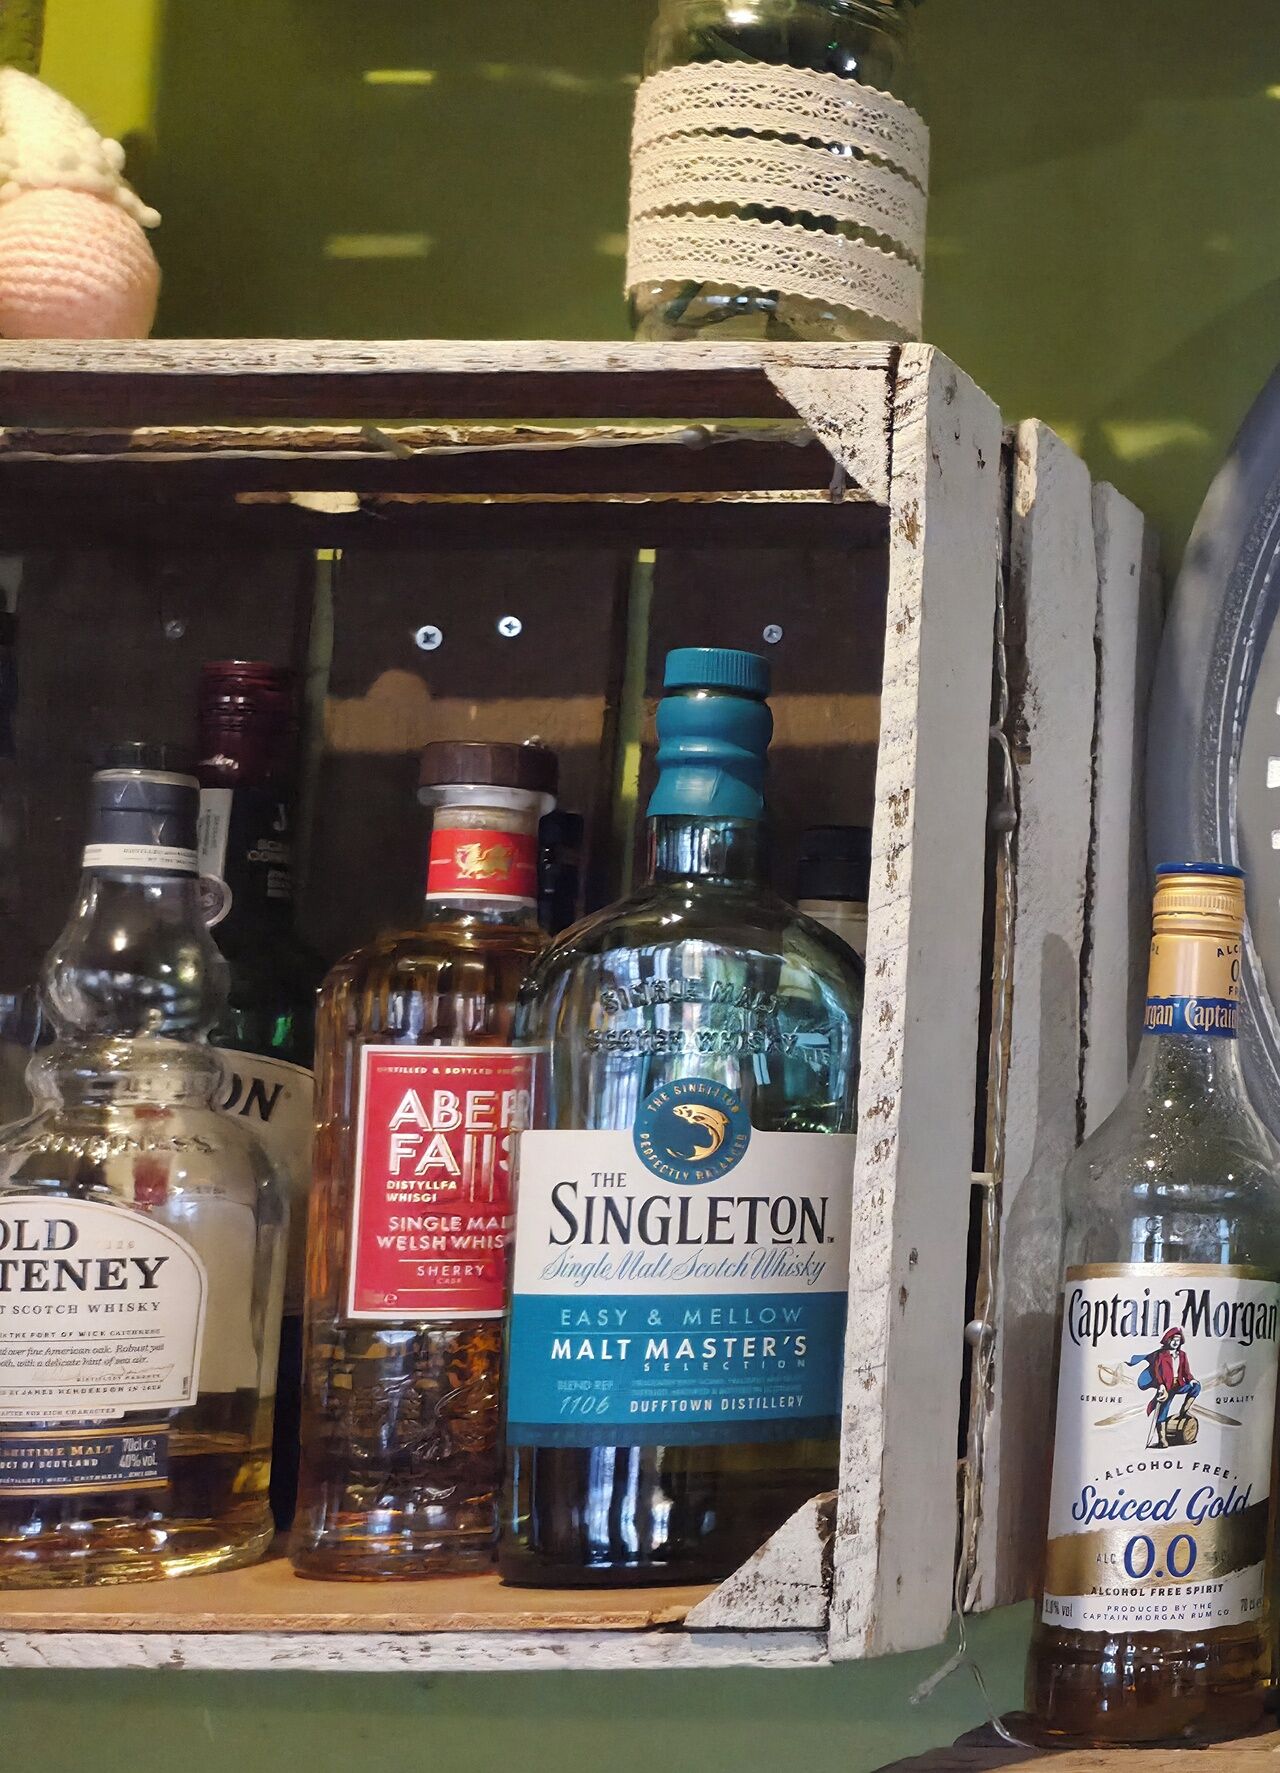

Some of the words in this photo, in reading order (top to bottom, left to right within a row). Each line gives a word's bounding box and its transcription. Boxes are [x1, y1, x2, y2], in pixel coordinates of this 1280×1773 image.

[386, 1180, 458, 1190] DISTYLLFA
[591, 1171, 628, 1188] THE
[386, 1193, 438, 1203] WHISGI
[548, 1180, 830, 1247] SINGLETON
[388, 1216, 462, 1232] SINGLE
[466, 1216, 507, 1231] MAL
[376, 1235, 447, 1251] WELSH
[450, 1234, 505, 1250] WHIS
[416, 1264, 485, 1277] SHERRY
[748, 1246, 829, 1286] Whisky
[12, 1304, 79, 1315] SCOTCH
[88, 1301, 161, 1314] WHISKY
[560, 1308, 627, 1326] EASY
[647, 1308, 662, 1325] &
[683, 1306, 803, 1325] MELLOW
[1067, 1287, 1173, 1348] Captain
[1174, 1288, 1278, 1347] Morgan
[551, 1337, 632, 1360] MALT
[645, 1335, 808, 1360] MASTER'S
[643, 1359, 807, 1372] SELECTION
[629, 1399, 713, 1414] DUFFTOWN
[720, 1395, 804, 1412] DISTILLERY
[1079, 1394, 1124, 1404] GENUINE
[1215, 1394, 1256, 1405] QUALITY
[1105, 1460, 1183, 1481] ALCOHOL
[1192, 1461, 1230, 1480] FREE
[1071, 1483, 1178, 1526] Spiced
[1185, 1482, 1254, 1527] Gold
[1122, 1533, 1198, 1580] 0.0
[1090, 1585, 1146, 1598] ALCOHOL
[1150, 1586, 1182, 1598] FREE
[1185, 1583, 1224, 1595] SPIRIT
[1107, 1605, 1169, 1613] PRODUCED
[1174, 1603, 1188, 1612] BY
[1193, 1601, 1213, 1610] THE
[1083, 1611, 1129, 1622] CAPTAIN
[1135, 1612, 1186, 1622] MORGAN
[1191, 1610, 1213, 1619] RUM
